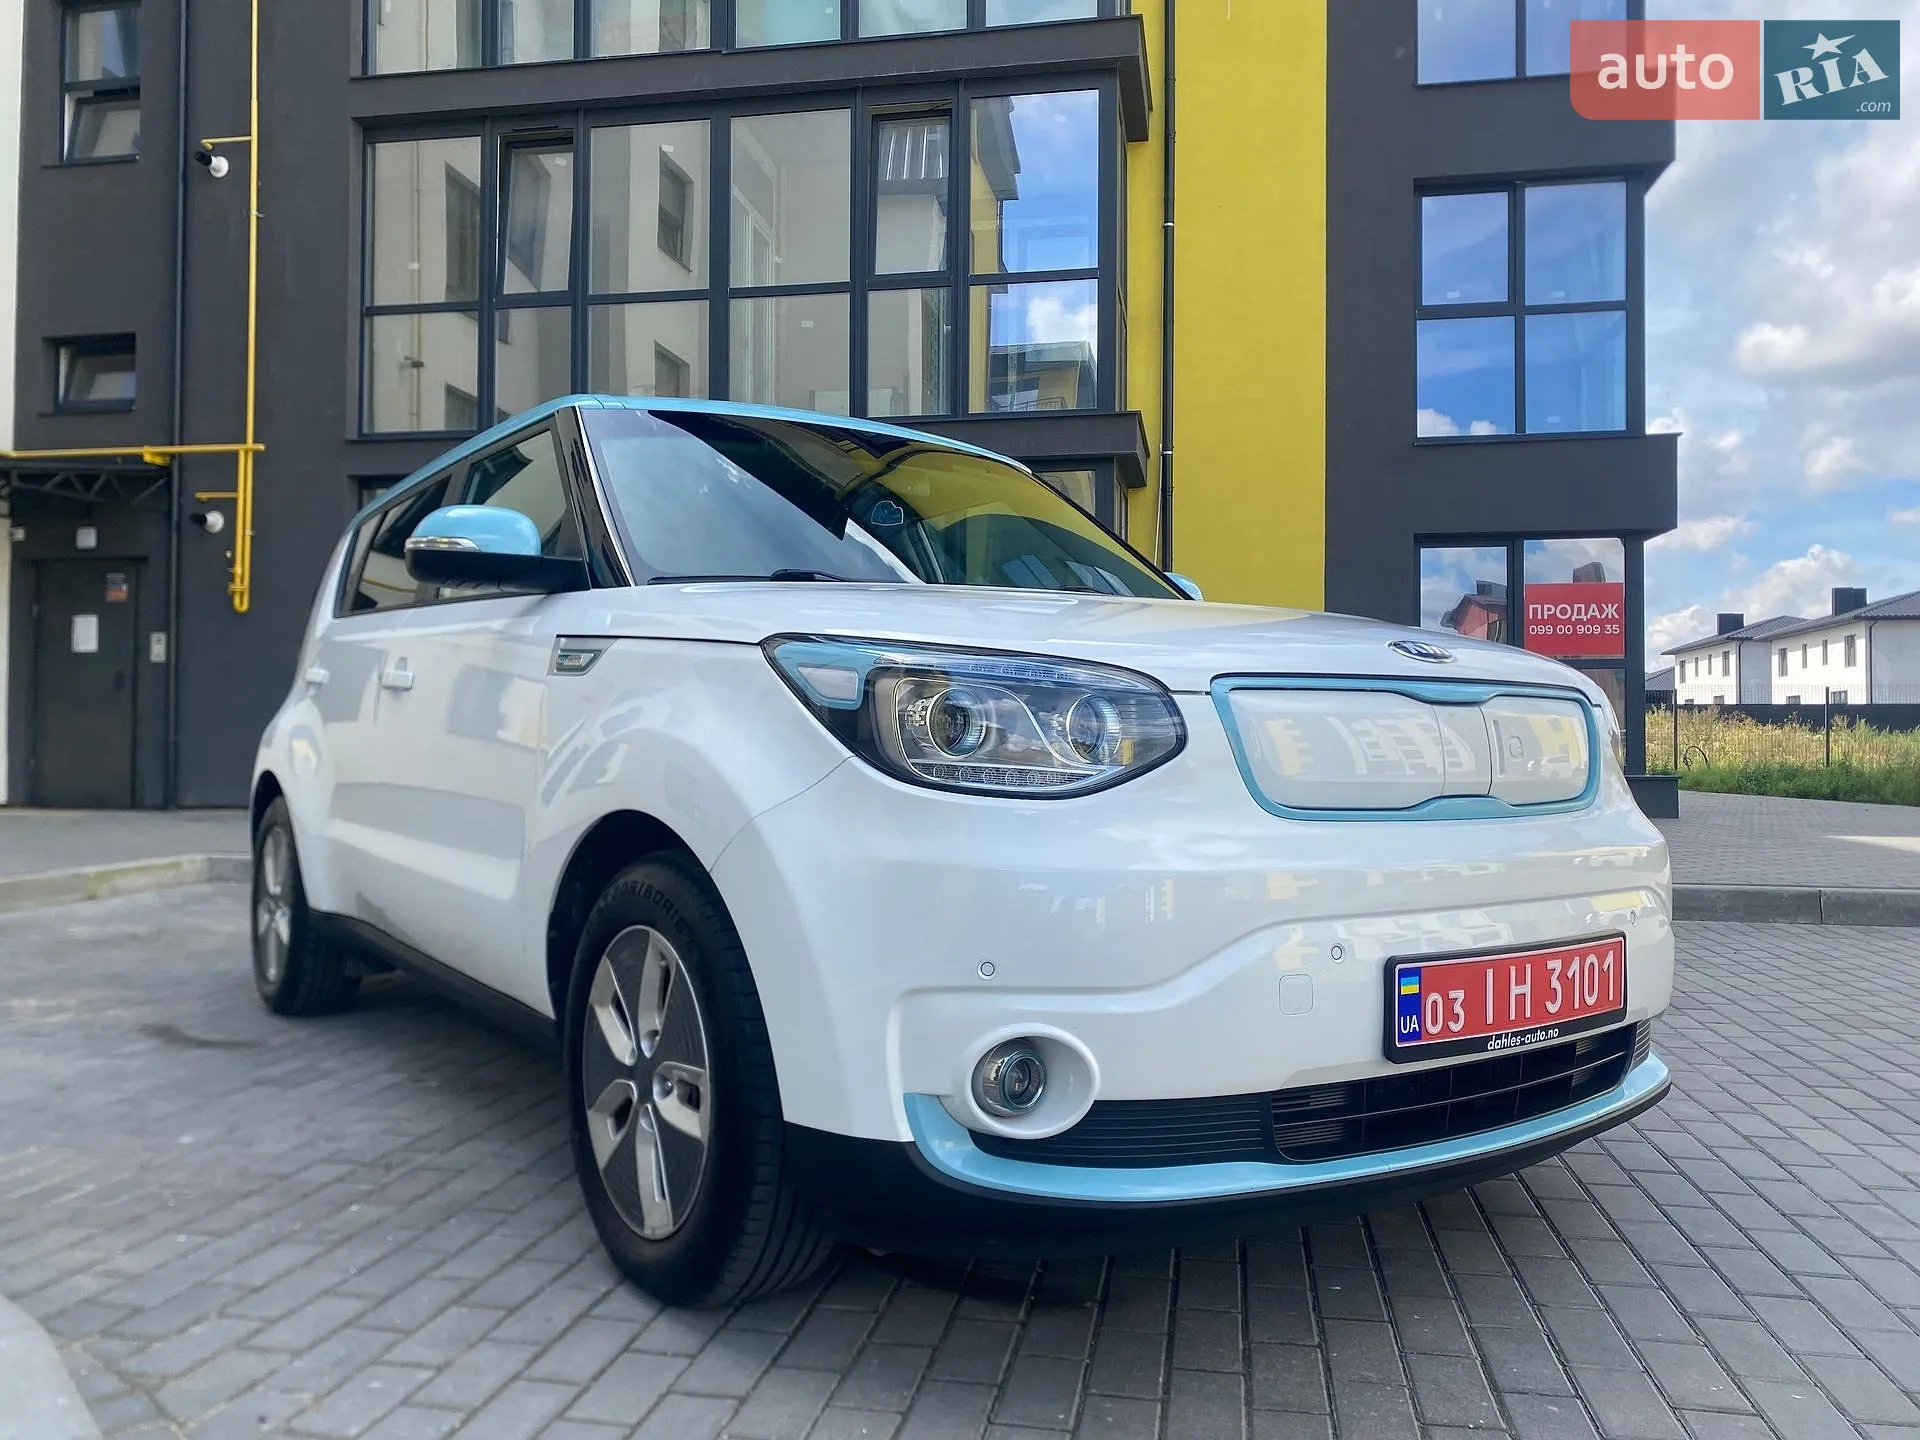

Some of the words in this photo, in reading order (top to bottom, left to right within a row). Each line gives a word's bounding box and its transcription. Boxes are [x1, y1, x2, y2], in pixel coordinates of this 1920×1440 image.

[1528, 603, 1620, 621] ПРОДАЖ
[1529, 625, 1553, 635] 099
[1556, 625, 1573, 635] 00
[1576, 624, 1601, 635] 909
[1604, 624, 1620, 634] 35
[1425, 989, 1466, 1035] 03
[1543, 950, 1615, 1015] 3101
[1400, 1015, 1420, 1034] UA
[1487, 1028, 1560, 1051] dahles-auto.no
